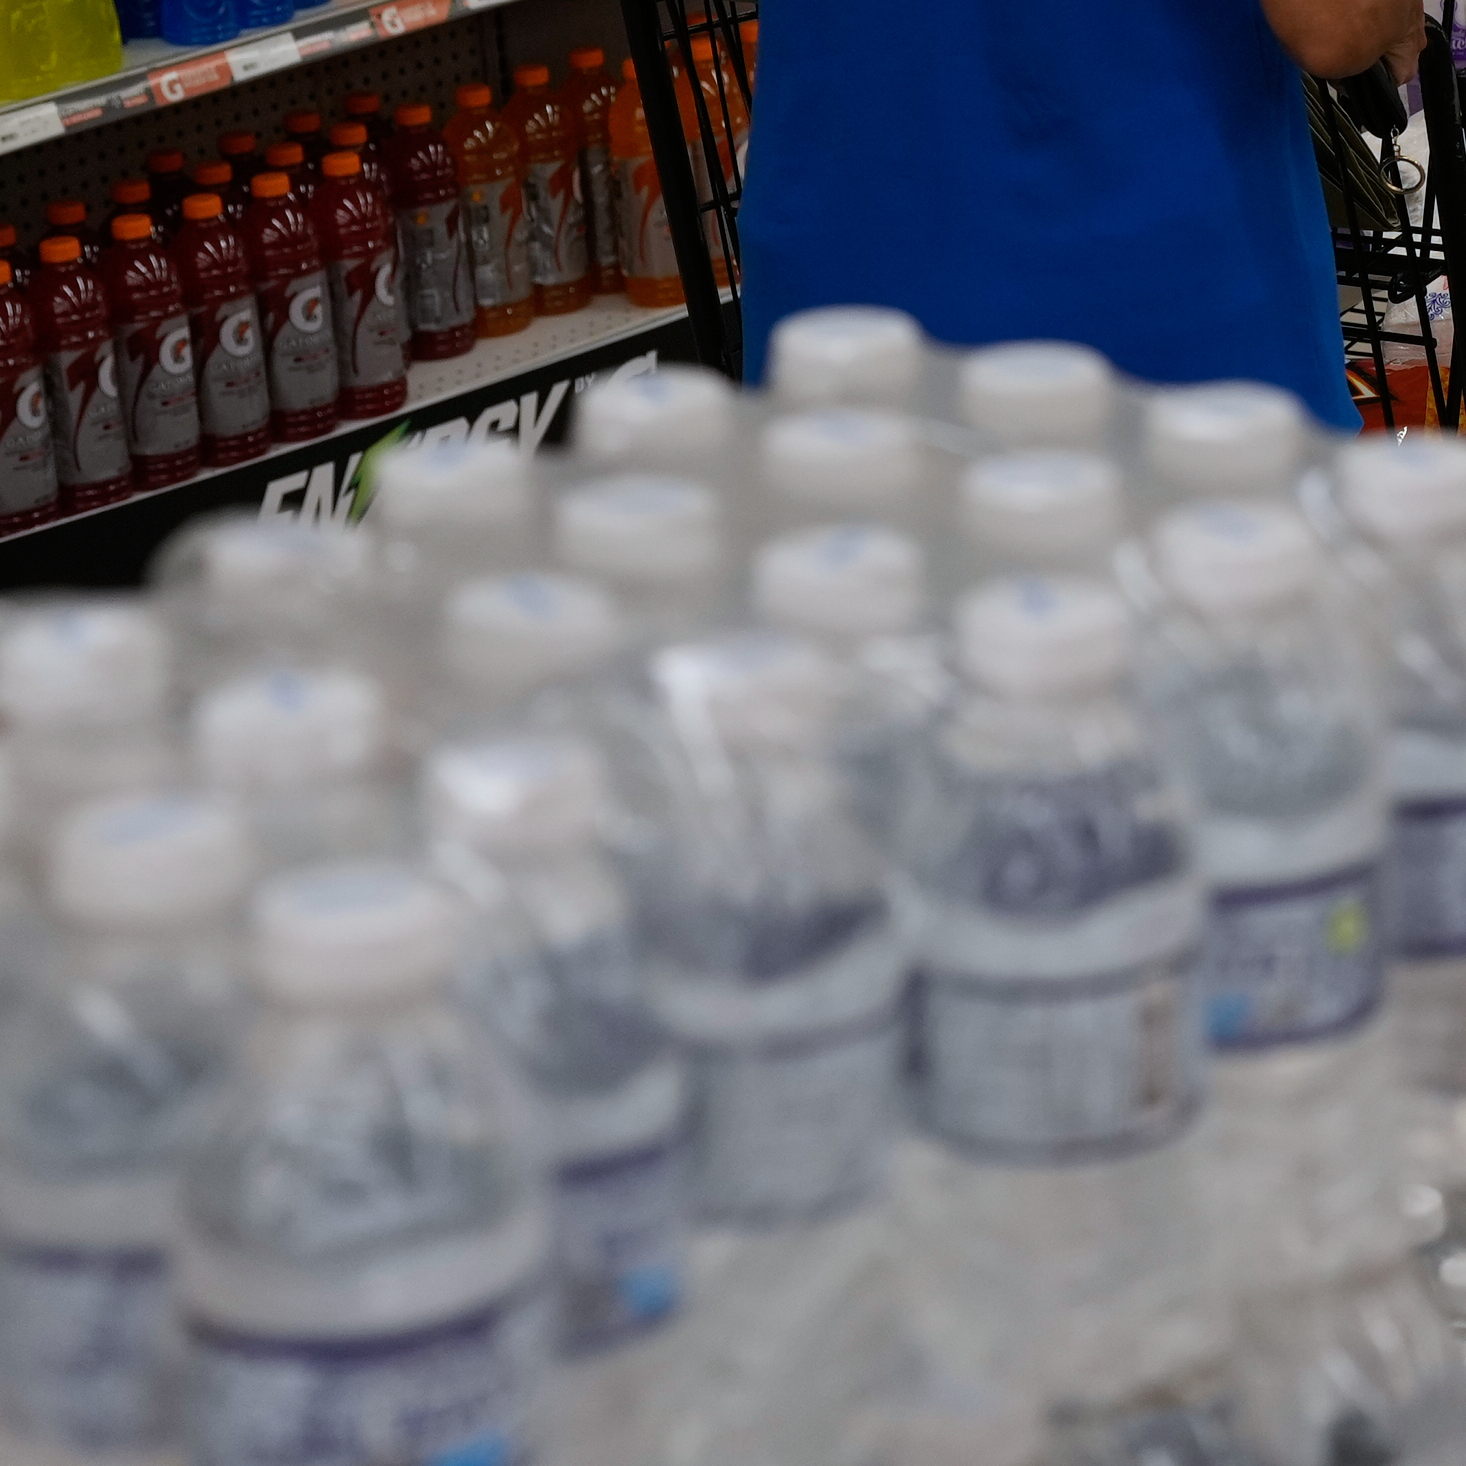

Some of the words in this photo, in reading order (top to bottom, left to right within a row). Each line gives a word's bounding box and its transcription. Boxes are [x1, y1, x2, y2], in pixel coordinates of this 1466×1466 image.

[381, 5, 405, 33] G
[160, 70, 187, 105] G
[288, 285, 323, 333] G
[219, 309, 255, 358] G
